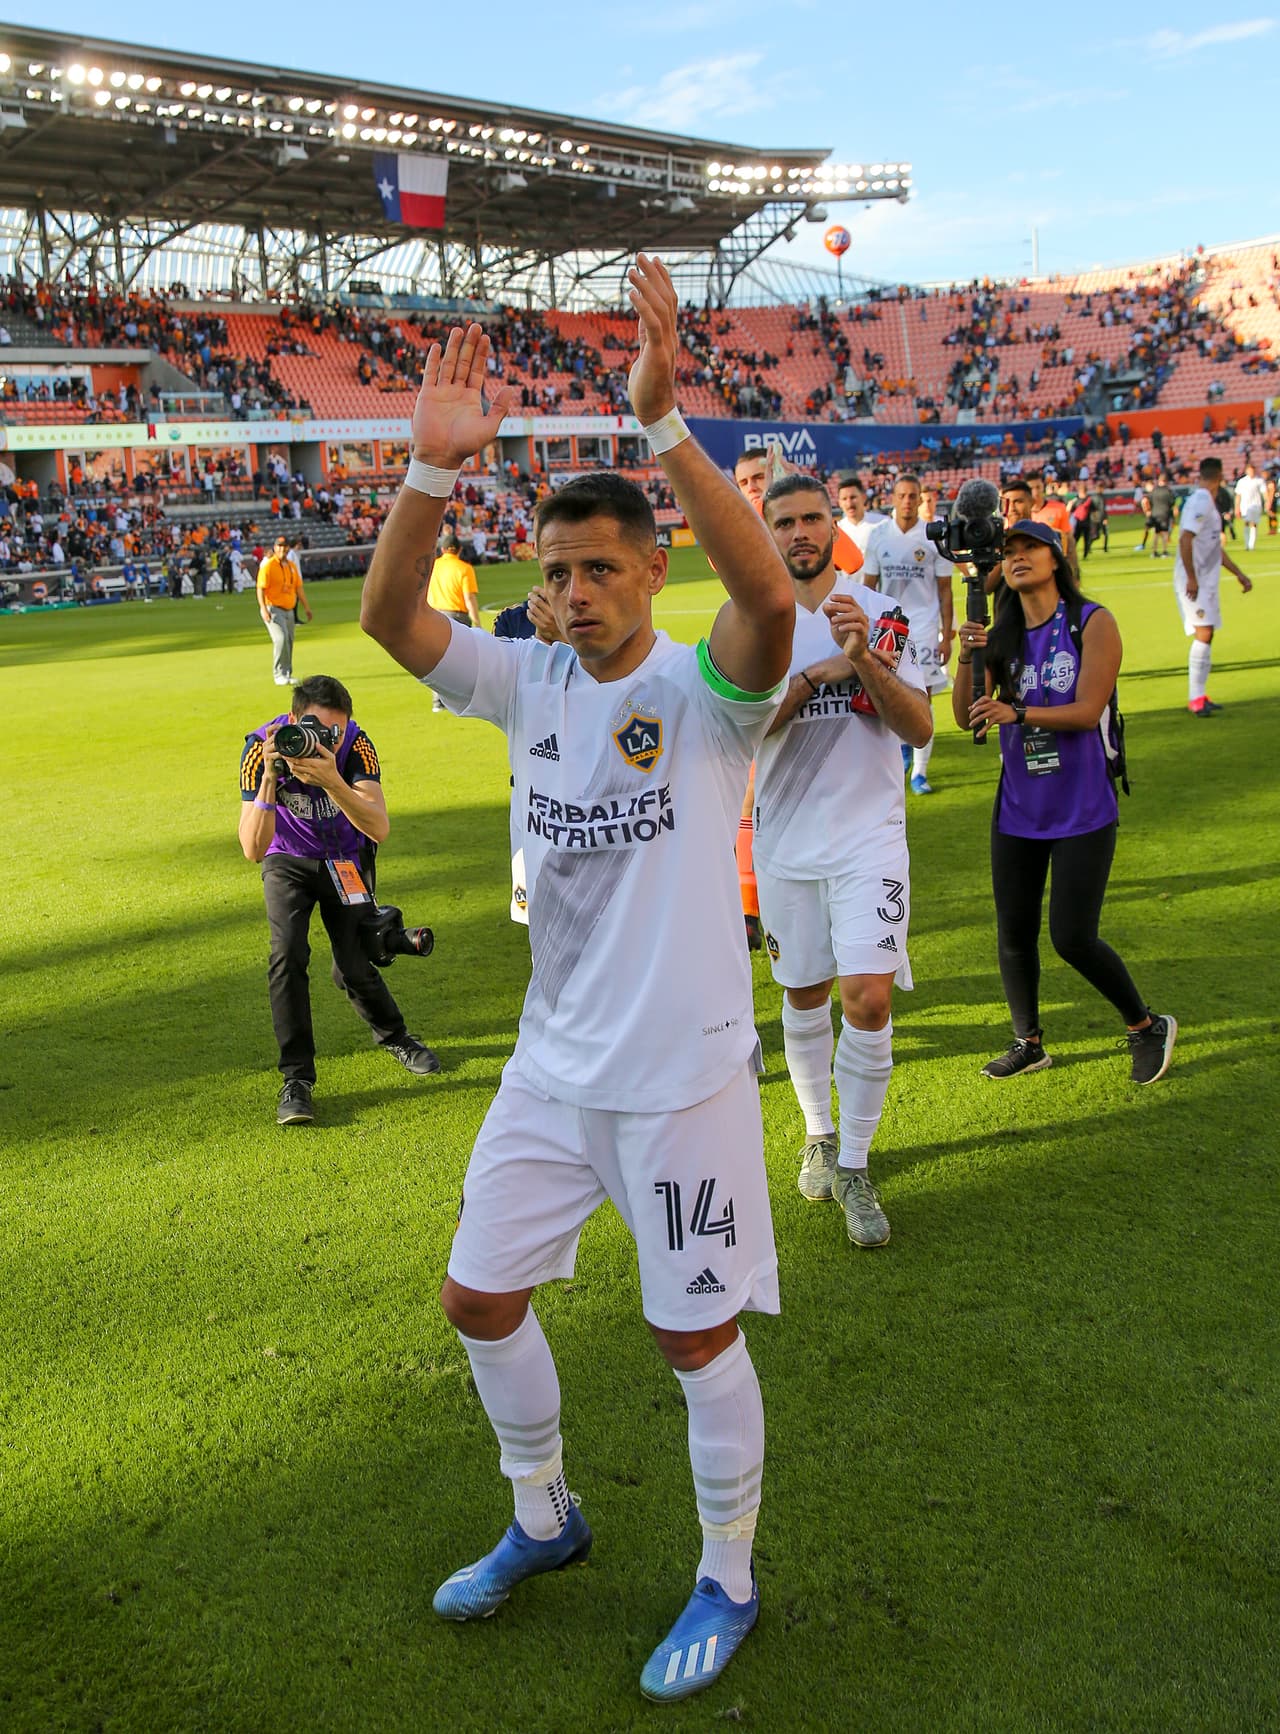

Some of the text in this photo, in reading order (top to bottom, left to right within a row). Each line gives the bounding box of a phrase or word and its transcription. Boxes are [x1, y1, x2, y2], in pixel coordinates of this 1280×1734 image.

[744, 428, 816, 454] BBVA
[626, 733, 657, 753] LA
[529, 747, 560, 762] adidas
[877, 878, 905, 925] 3
[877, 942, 898, 953] adidas
[654, 1178, 737, 1251] 14
[686, 1283, 727, 1295] adidas
